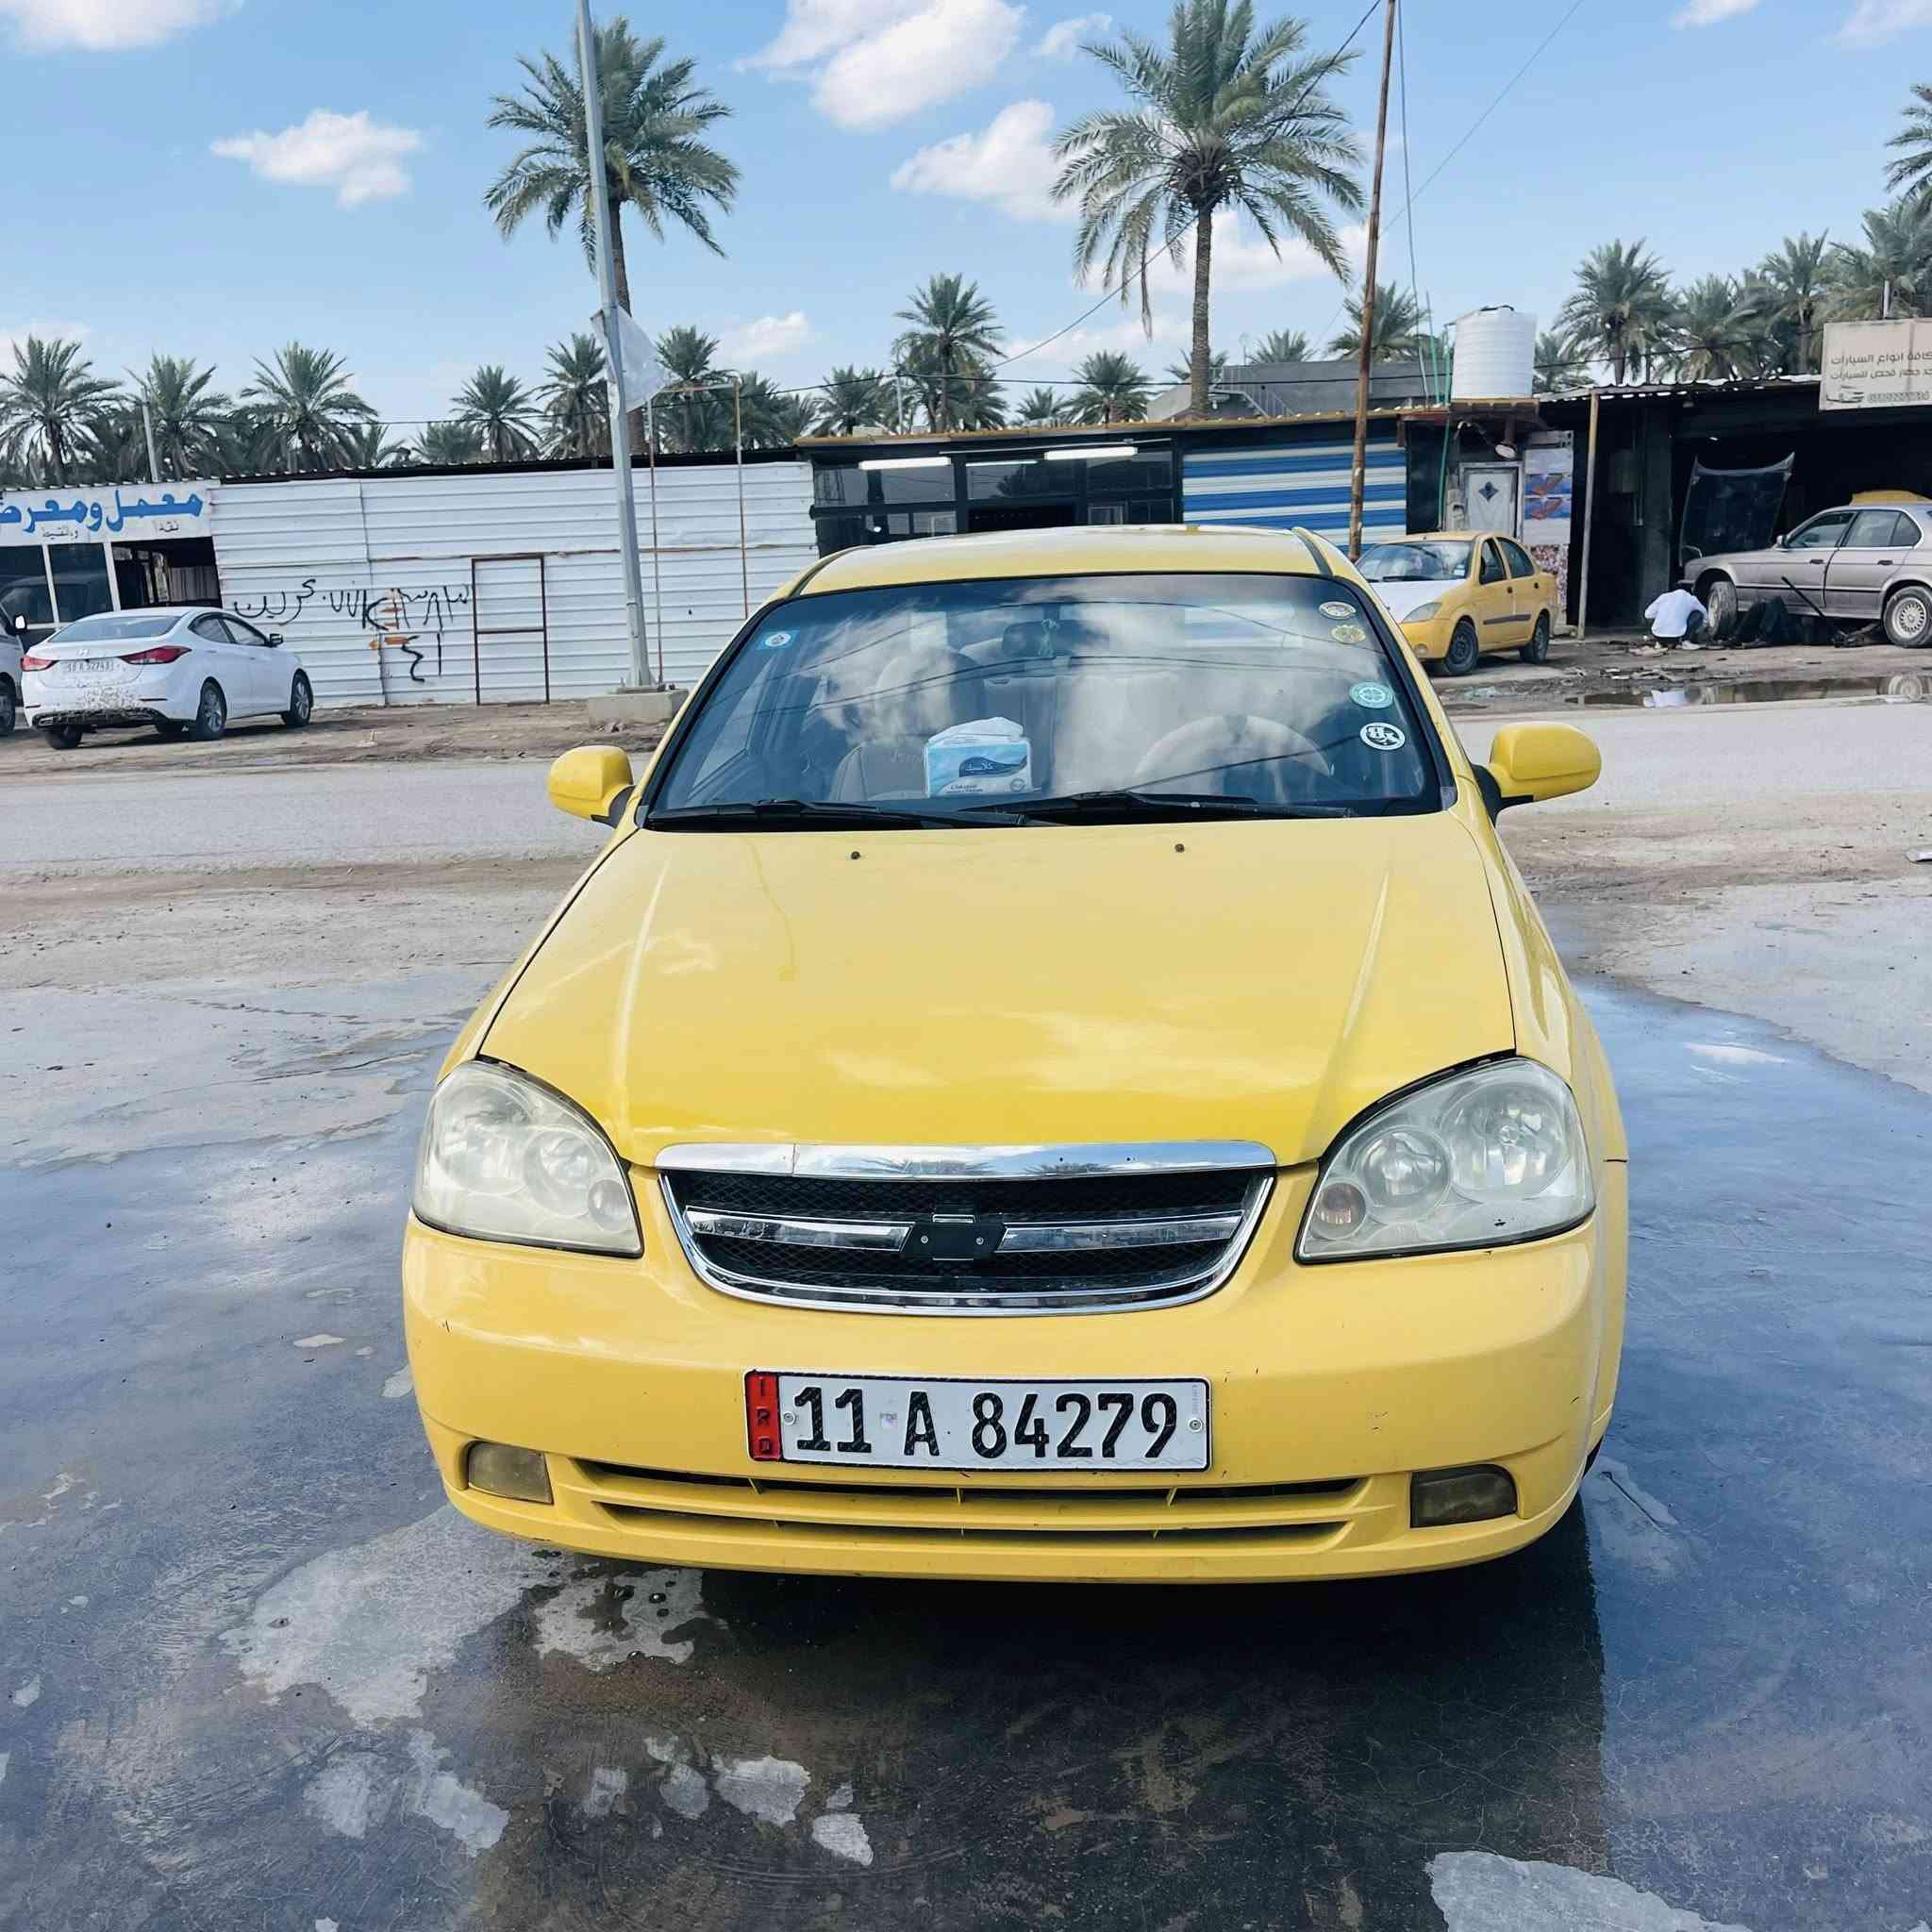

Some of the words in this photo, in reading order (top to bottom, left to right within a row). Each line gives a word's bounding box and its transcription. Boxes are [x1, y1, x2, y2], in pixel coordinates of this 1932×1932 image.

[106, 489, 204, 533] معمل
[794, 1386, 873, 1454] 11
[903, 1391, 941, 1457] A
[971, 1391, 1178, 1459] 84279
